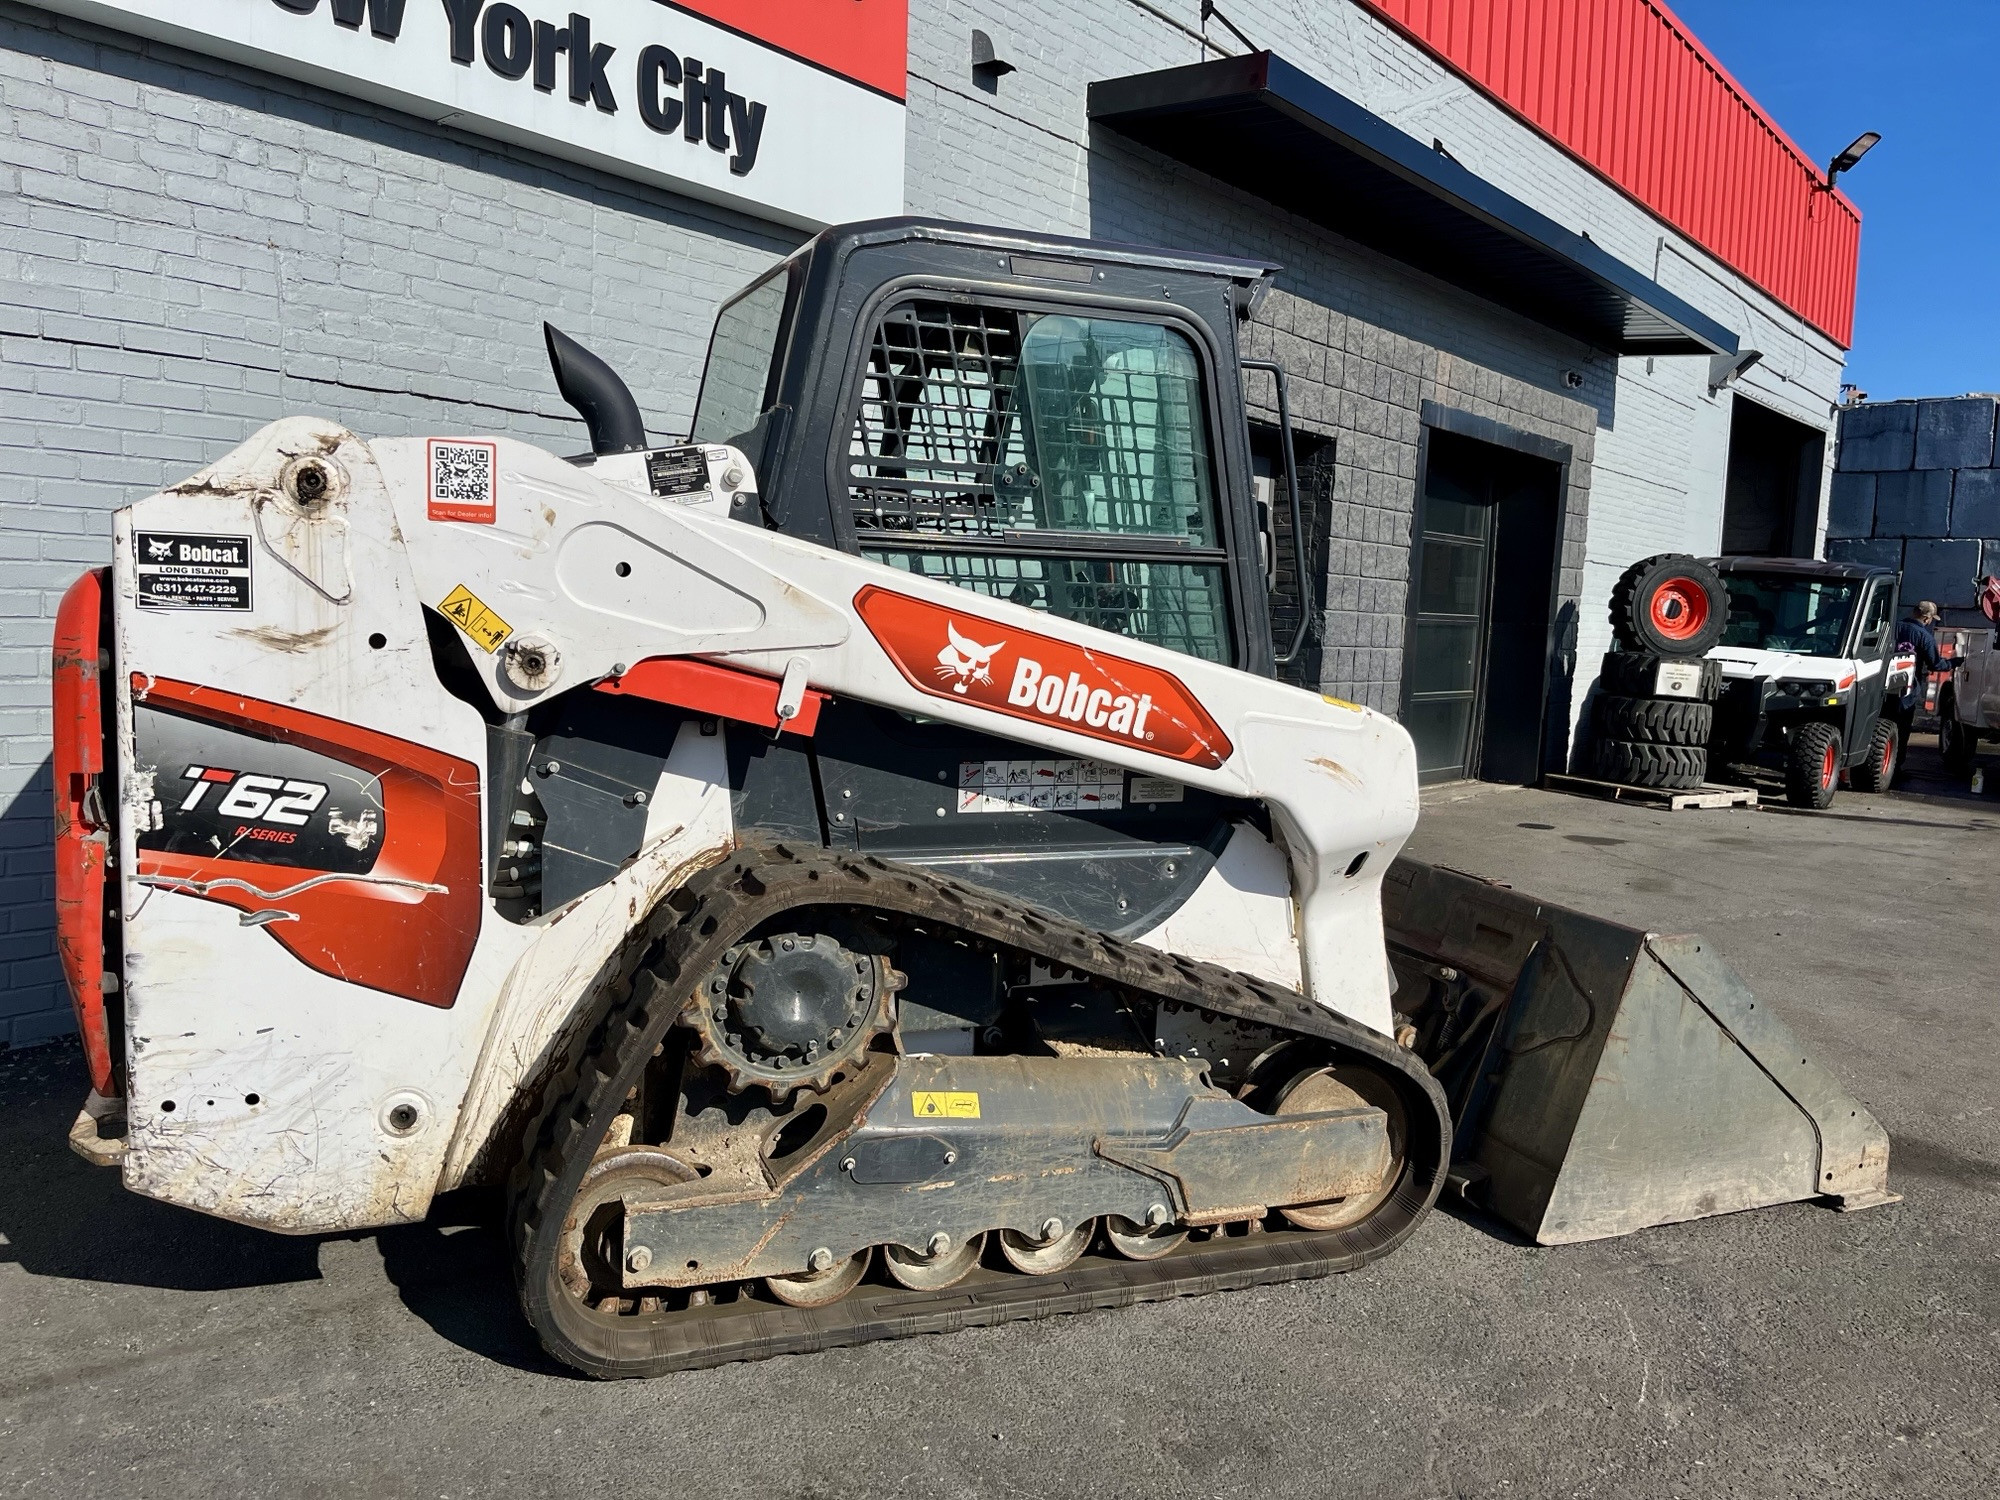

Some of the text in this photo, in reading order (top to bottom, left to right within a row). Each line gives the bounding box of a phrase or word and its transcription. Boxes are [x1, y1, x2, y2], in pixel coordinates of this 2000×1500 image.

[443, 0, 767, 177] York City
[457, 510, 477, 518] Dealer
[179, 544, 239, 563] Bobcat
[159, 566, 229, 575] LONG ISLAND
[151, 583, 237, 594] (631) 447-2228
[1007, 657, 1153, 740] Bobcat
[180, 765, 328, 826] T62
